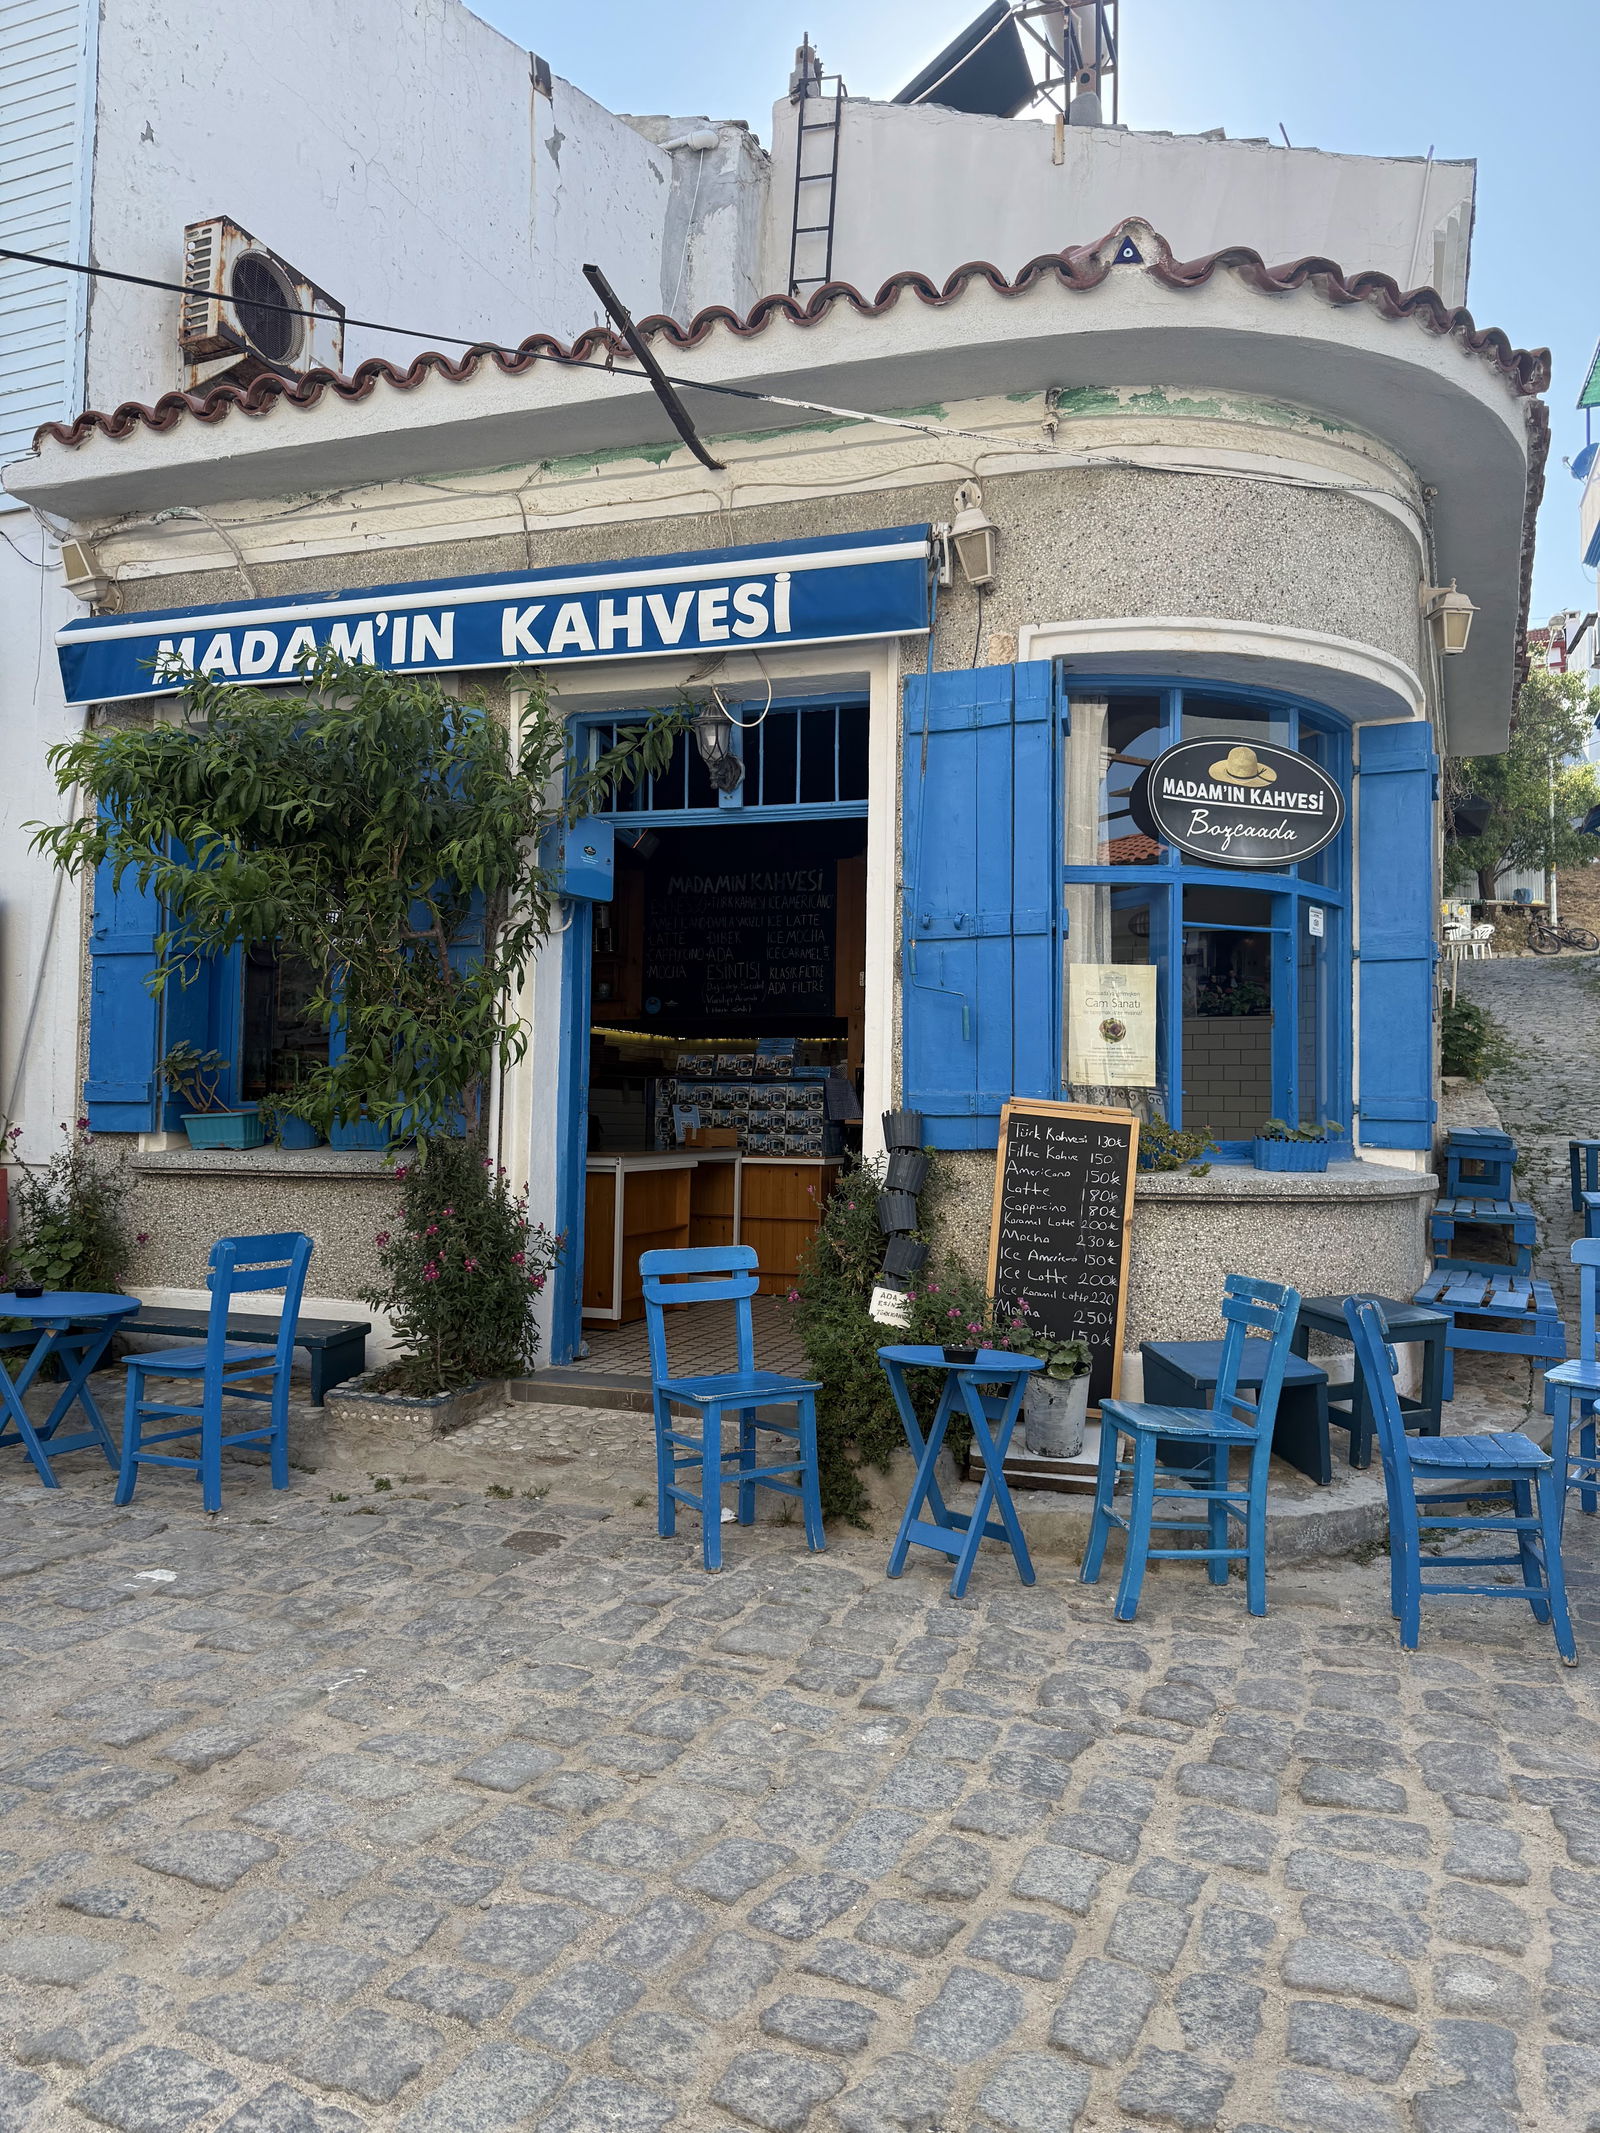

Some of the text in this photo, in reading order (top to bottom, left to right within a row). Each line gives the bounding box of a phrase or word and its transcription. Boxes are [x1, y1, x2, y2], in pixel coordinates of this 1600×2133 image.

[152, 572, 791, 685] MADAM'IN KAHVESİ
[1163, 777, 1324, 811] MADAM'IN KAHVESİ
[1186, 808, 1297, 852] Bozcaada
[786, 913, 822, 928] LATTE
[707, 947, 735, 962] ADA
[767, 981, 788, 995] ADA
[1085, 997, 1141, 1009] Cam Sanatı
[1010, 1121, 1041, 1140] Türk
[1046, 1126, 1088, 1144] Kahvesi
[1008, 1141, 1040, 1159] Filtre
[1091, 1153, 1113, 1165] 150
[1005, 1160, 1071, 1178] Americano
[1006, 1178, 1051, 1197] Latte
[1003, 1196, 1067, 1215] Cappucino
[1048, 1217, 1075, 1227] Latte
[1002, 1228, 1050, 1243] Mocha
[1027, 1268, 1068, 1285] Latte
[880, 1292, 898, 1301] ADA
[1089, 1292, 1114, 1306] 220
